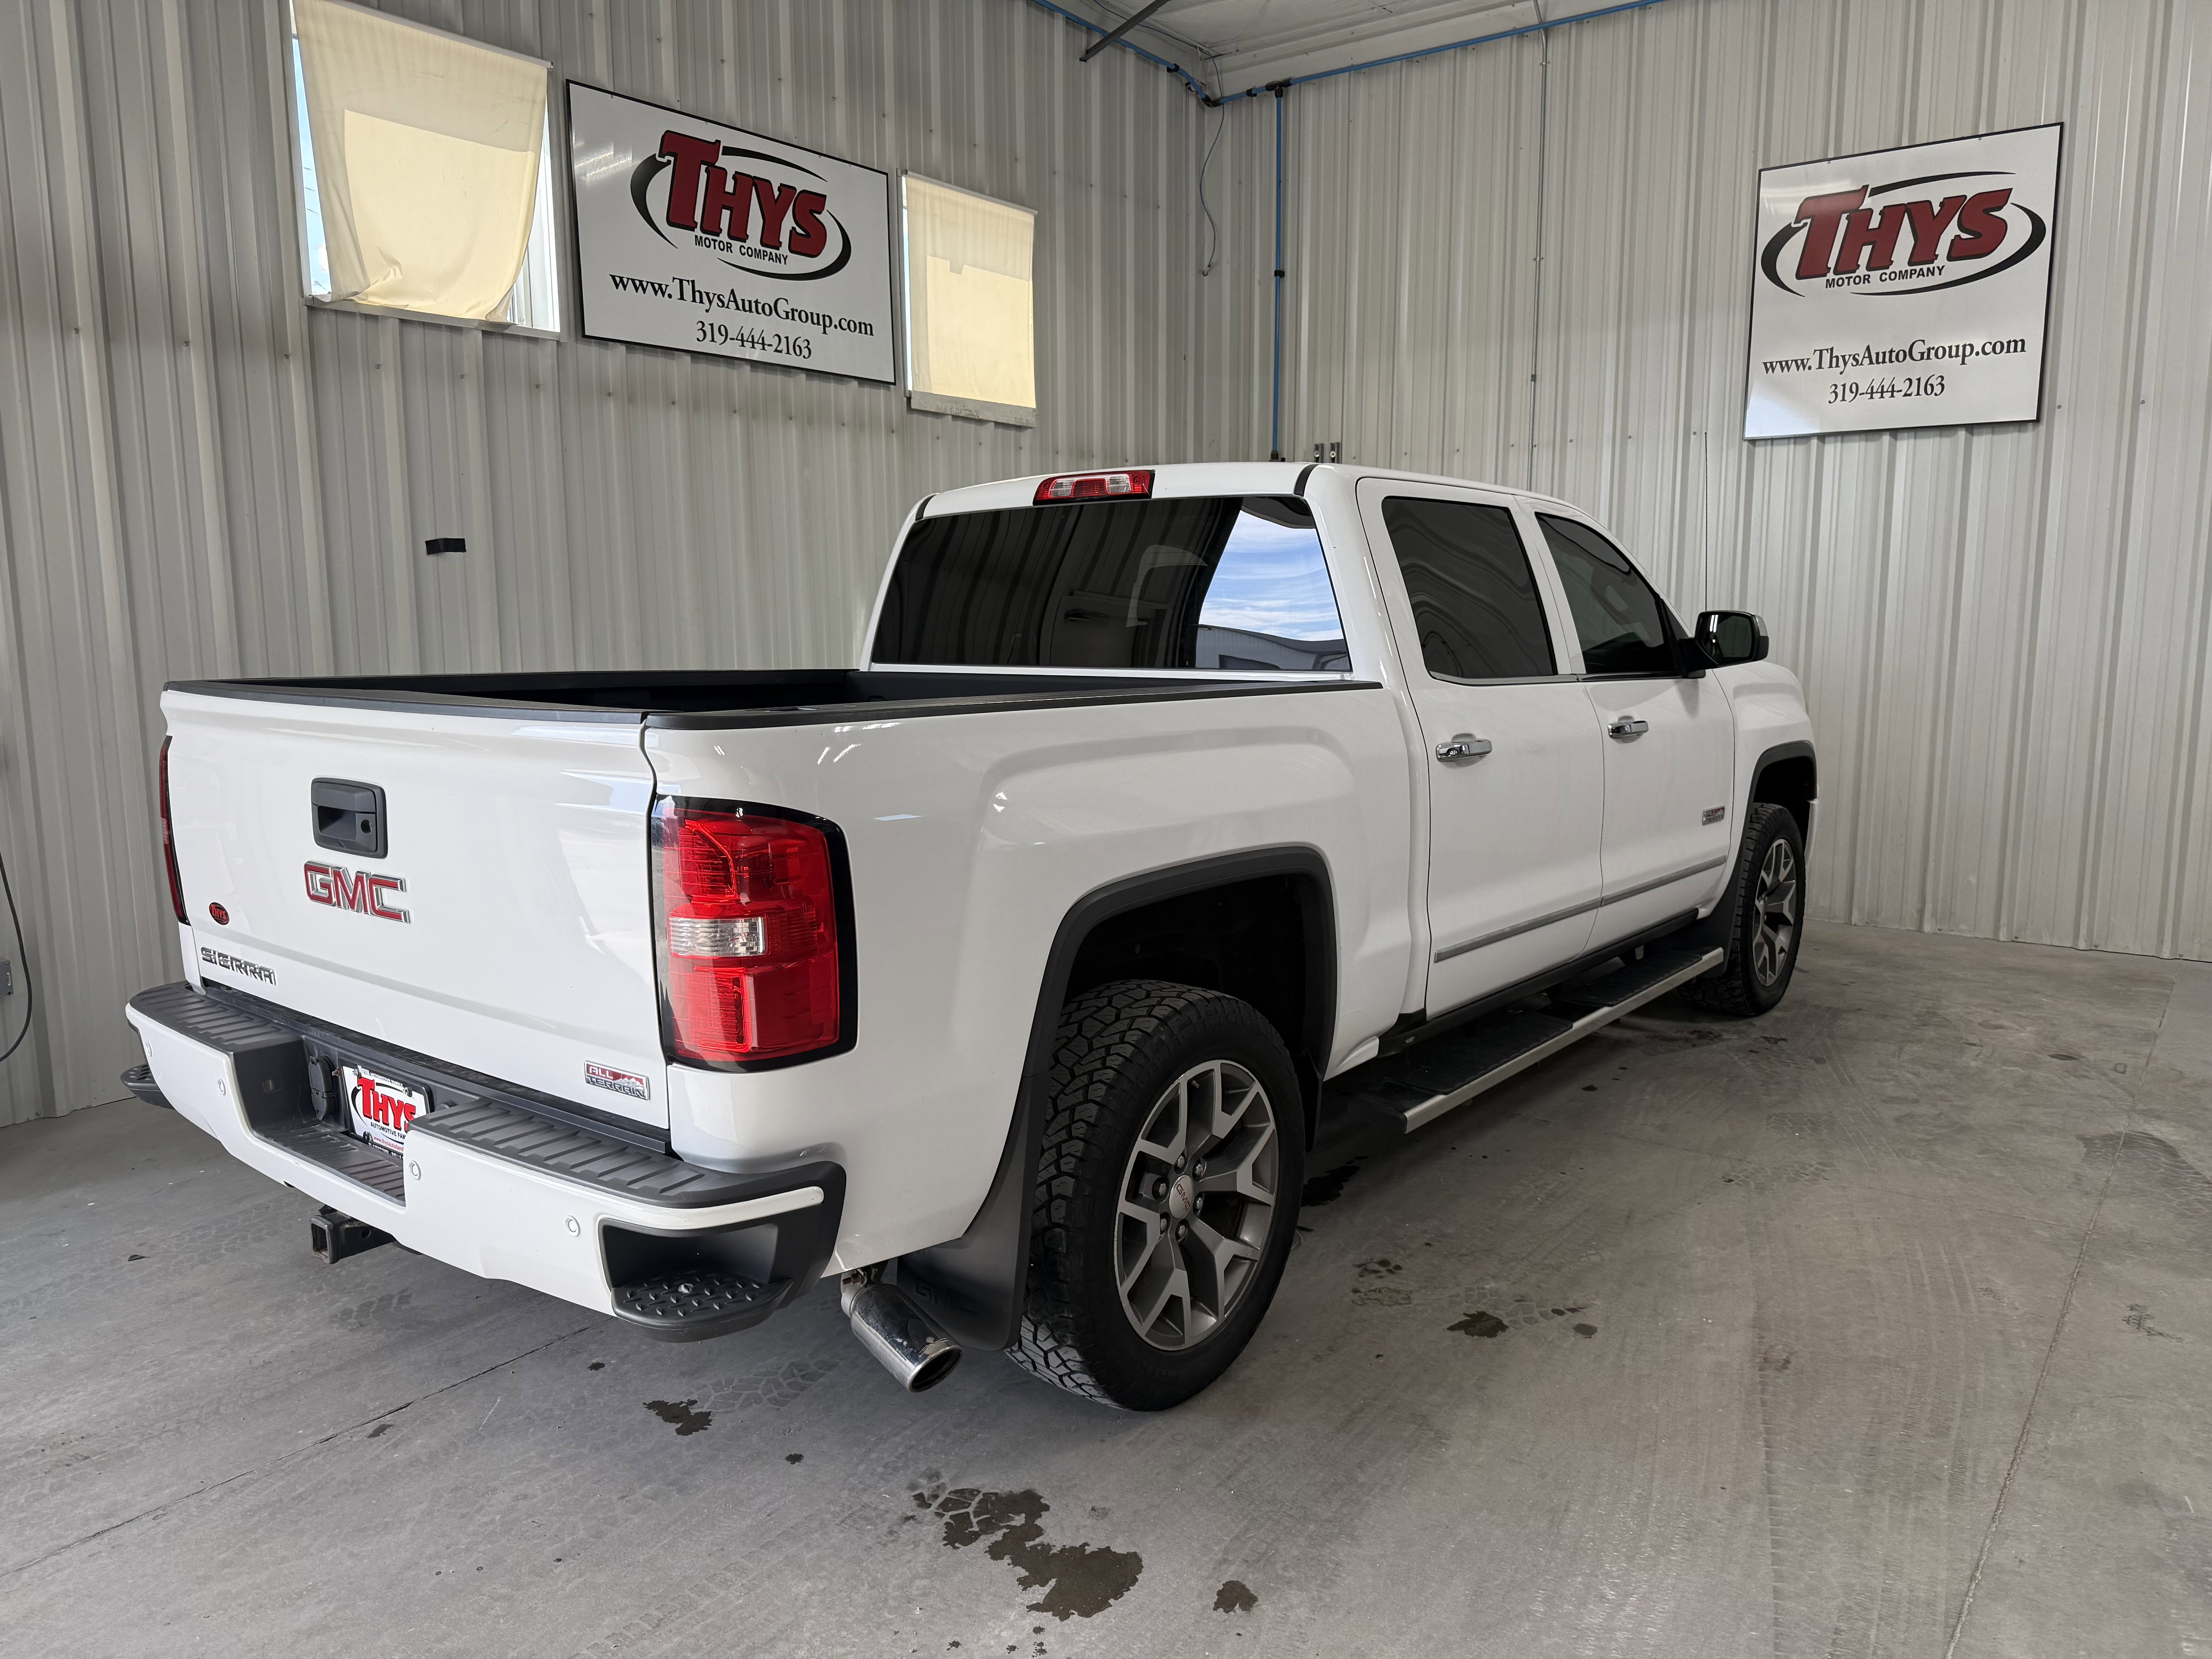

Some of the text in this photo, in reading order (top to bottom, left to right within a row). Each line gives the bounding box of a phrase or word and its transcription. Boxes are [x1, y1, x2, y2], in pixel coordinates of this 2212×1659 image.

[658, 130, 828, 259] THYS
[1795, 184, 2014, 280] THYS
[694, 235, 788, 266] MOTOR COMPANY
[1825, 265, 1946, 289] MOTOR COMPANY
[609, 274, 874, 337] www.ThysAutoGroup.com
[696, 320, 812, 359] 319-444-2163
[1762, 338, 2026, 375] www.ThysAutoGroup.com
[1828, 374, 1945, 404] 319-444-2163
[304, 860, 410, 924] GMC
[201, 946, 277, 986] SIERRA
[586, 1075, 646, 1099] TERRAIN
[589, 1066, 613, 1079] ALL
[371, 1121, 397, 1137] AUTOMOTIVE
[1176, 1183, 1190, 1211] GMC
